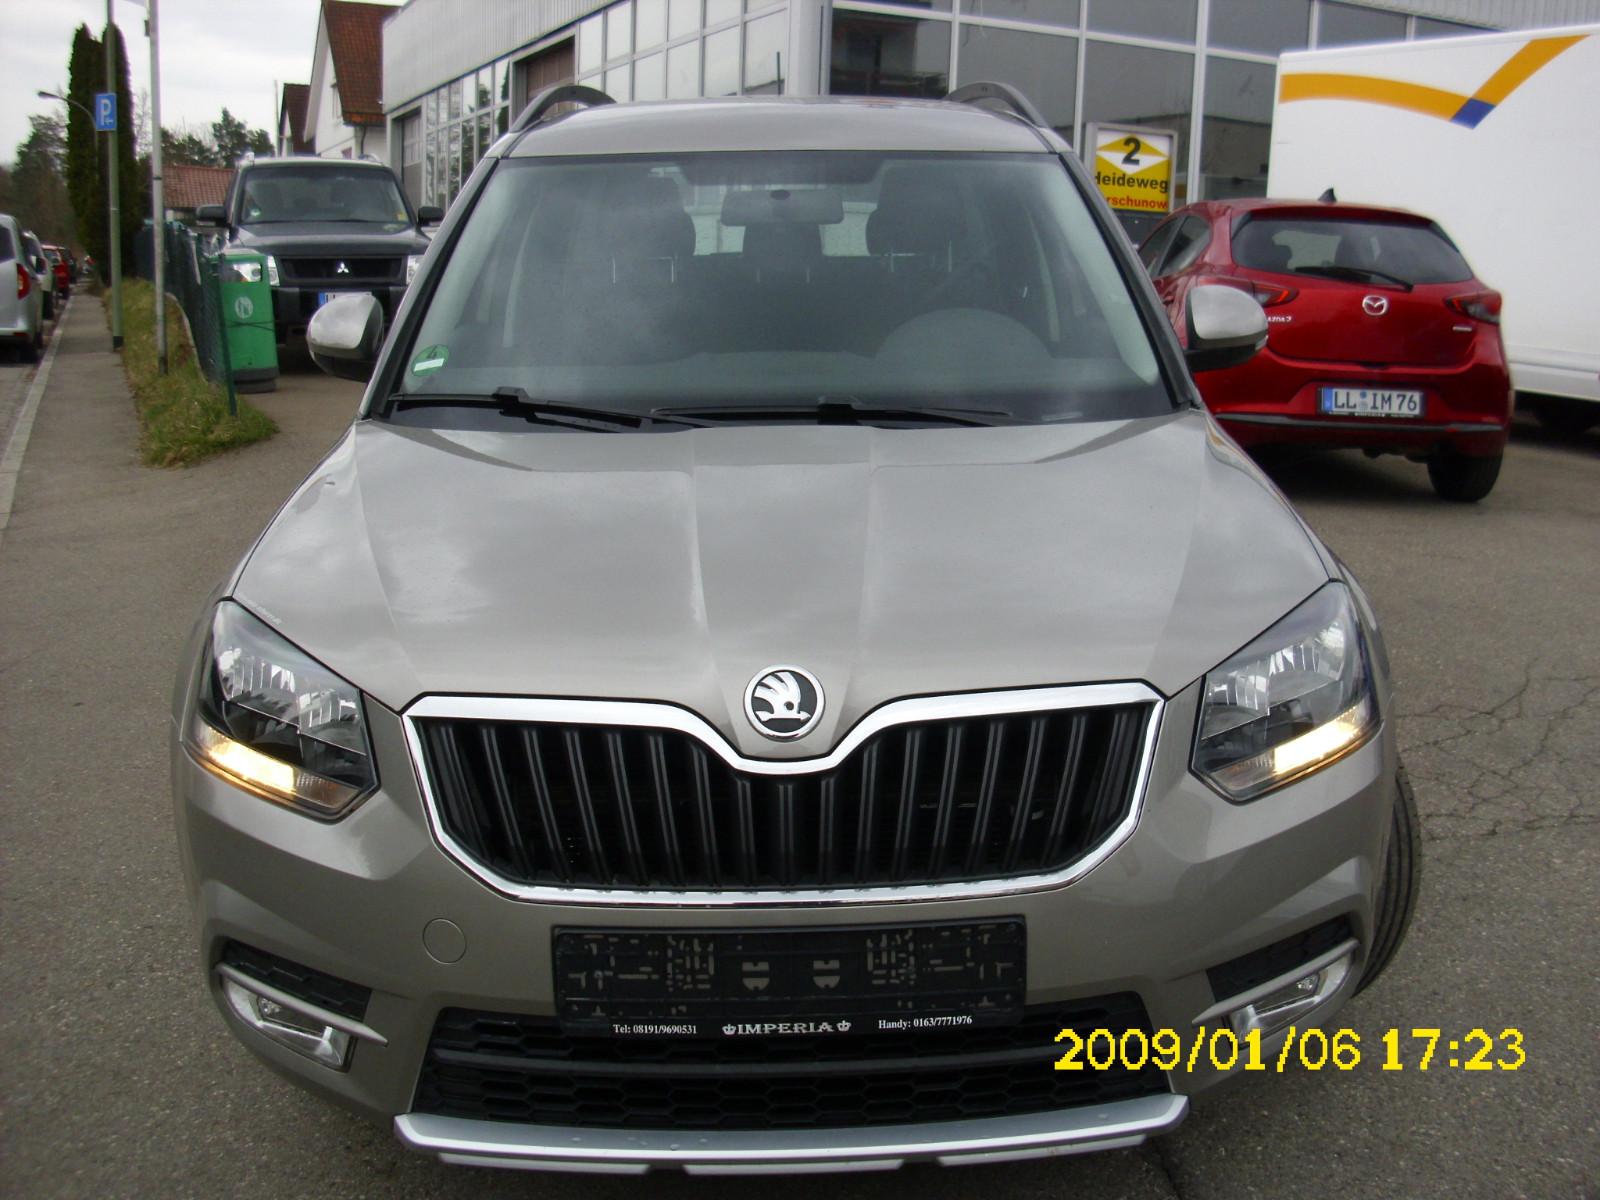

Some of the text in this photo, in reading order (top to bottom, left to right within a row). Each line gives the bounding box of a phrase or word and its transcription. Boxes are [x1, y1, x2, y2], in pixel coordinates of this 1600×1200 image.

[100, 99, 111, 126] P
[1121, 137, 1141, 166] 2
[1106, 196, 1168, 209] rschunow
[1334, 391, 1418, 412] LL IM 76
[612, 1024, 697, 1034] Tel: 08191/9690531
[737, 1021, 834, 1035] IMPERIA
[878, 1016, 973, 1031] Handy: 0163/7771976
